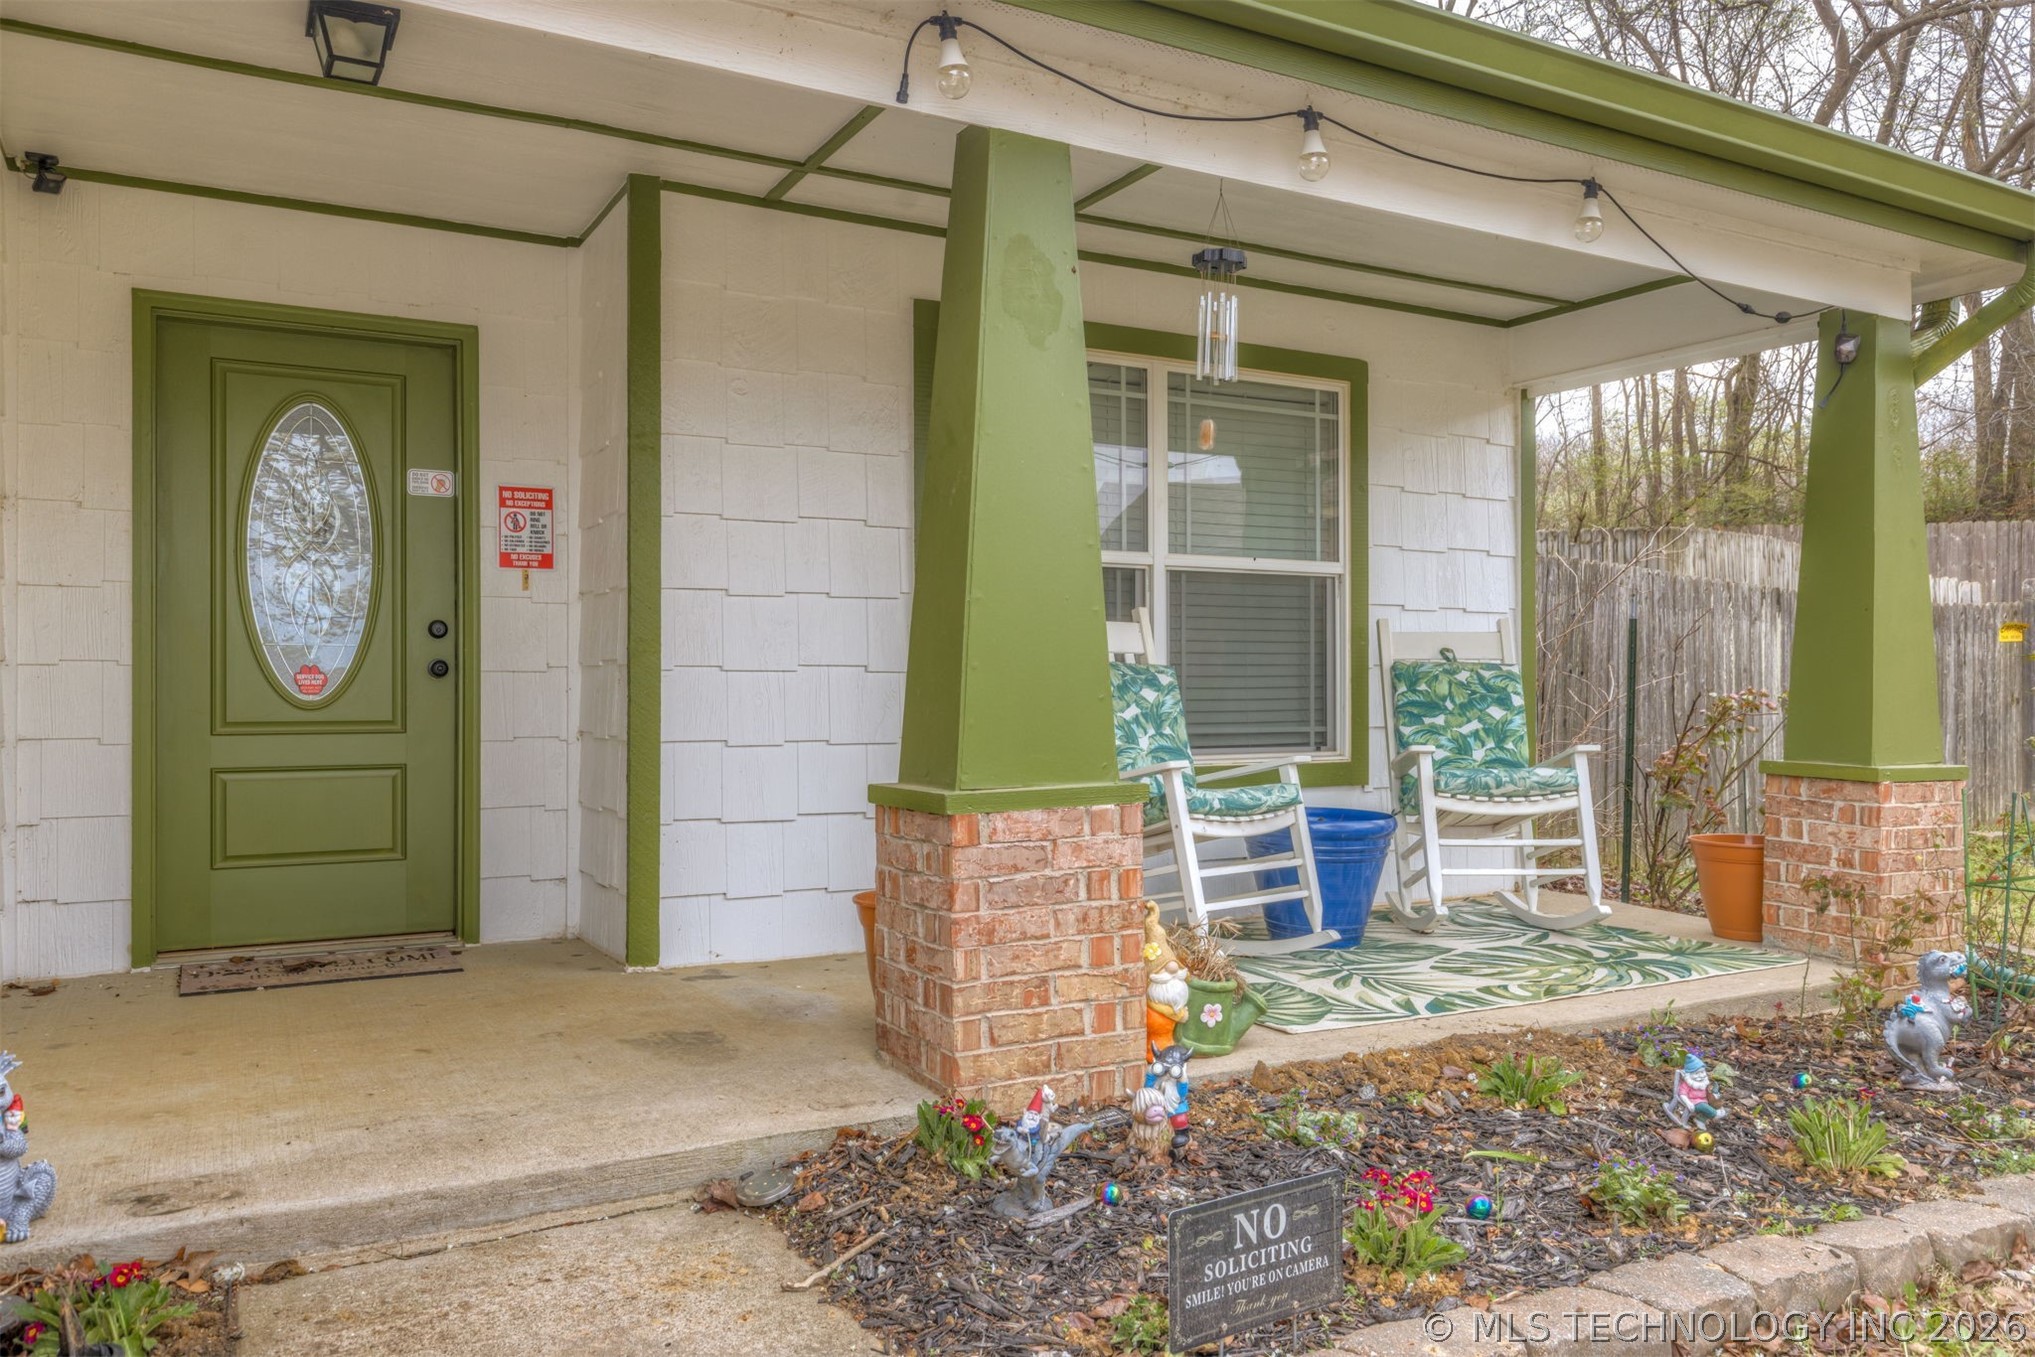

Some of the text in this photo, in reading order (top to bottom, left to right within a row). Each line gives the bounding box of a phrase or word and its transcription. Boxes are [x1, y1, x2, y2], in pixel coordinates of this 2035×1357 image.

[514, 492, 549, 500] SOLICITING
[1234, 1203, 1287, 1250] NO
[1185, 1255, 1329, 1309] SMILE! YOU'RE ON CAMERA
[1204, 1236, 1312, 1282] SOLICITING
[1230, 1290, 1289, 1316] Thank you
